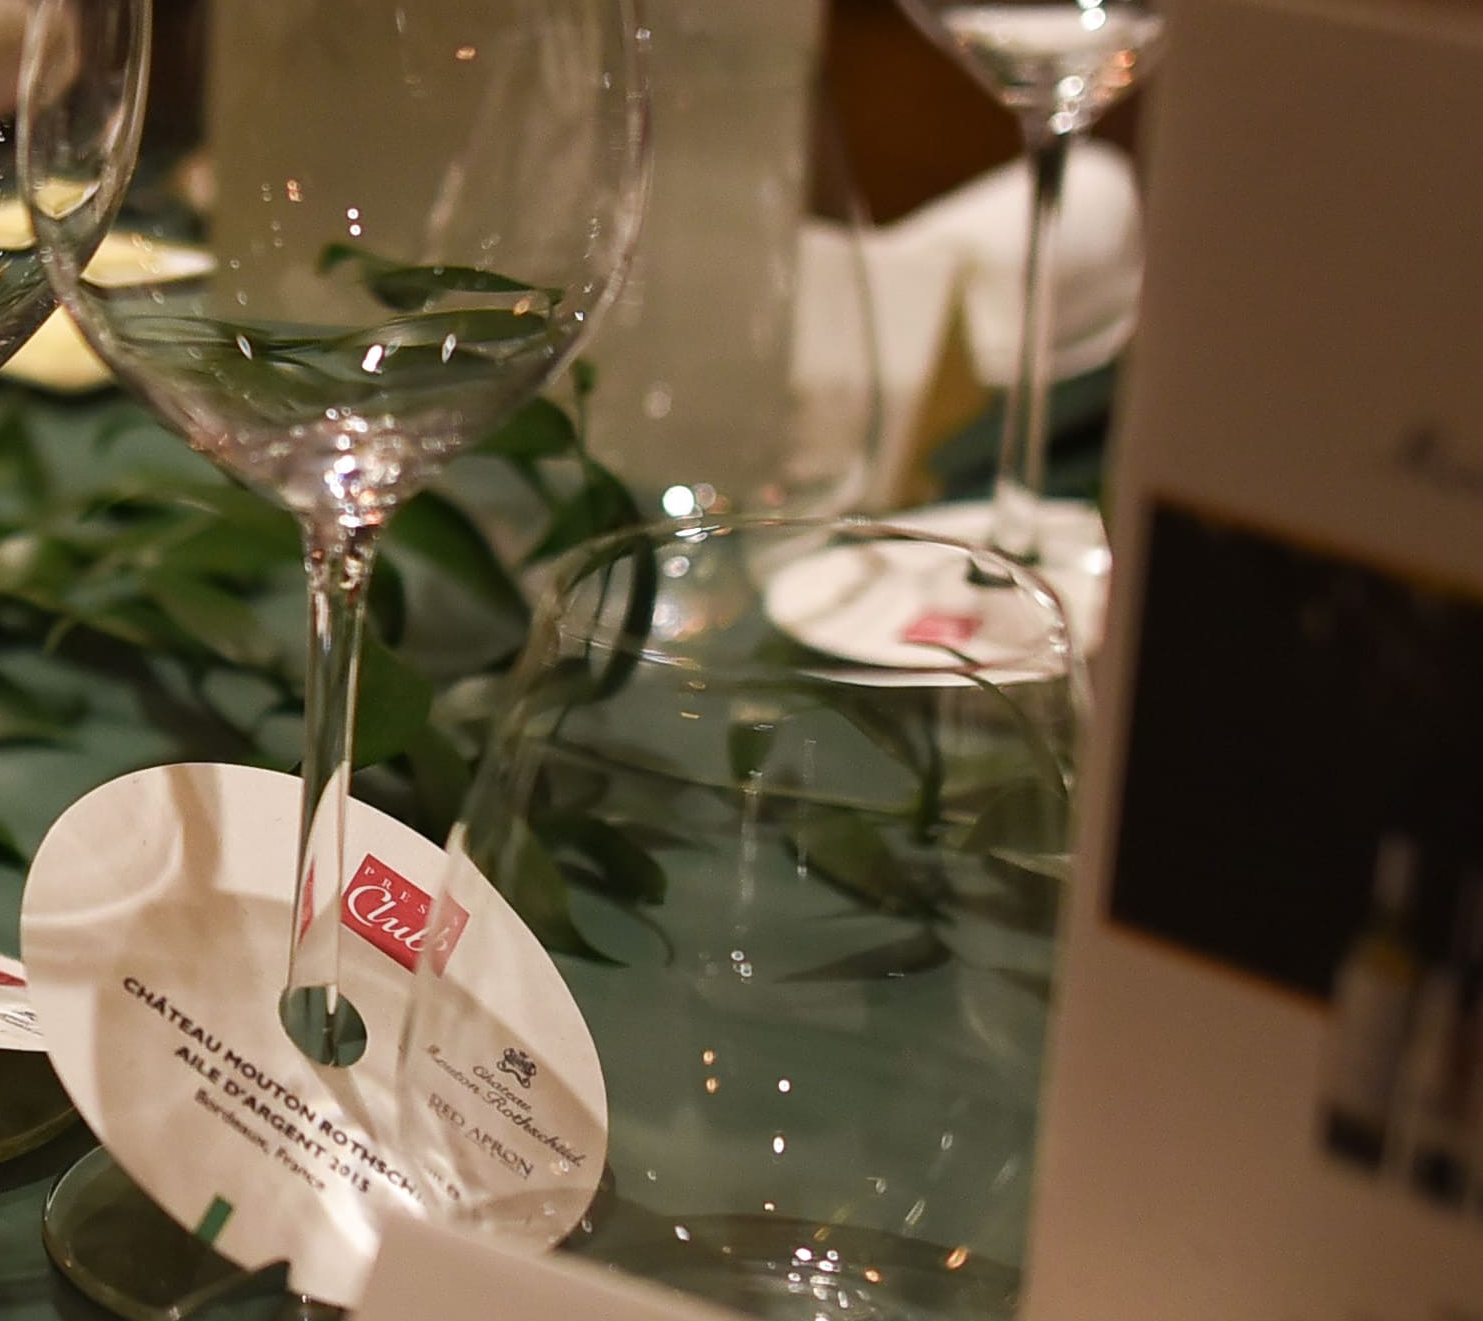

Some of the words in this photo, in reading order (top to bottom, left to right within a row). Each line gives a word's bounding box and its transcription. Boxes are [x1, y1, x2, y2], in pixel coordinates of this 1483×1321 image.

[348, 885, 448, 952] Club
[364, 866, 460, 926] PRES
[174, 1046, 221, 1085] AILE
[223, 1079, 327, 1159] D'ARGENT
[224, 1049, 316, 1123] MOUTON
[319, 1120, 461, 1201] ROTHSCHD
[428, 1093, 465, 1127] RED
[465, 1127, 534, 1179] APRON
